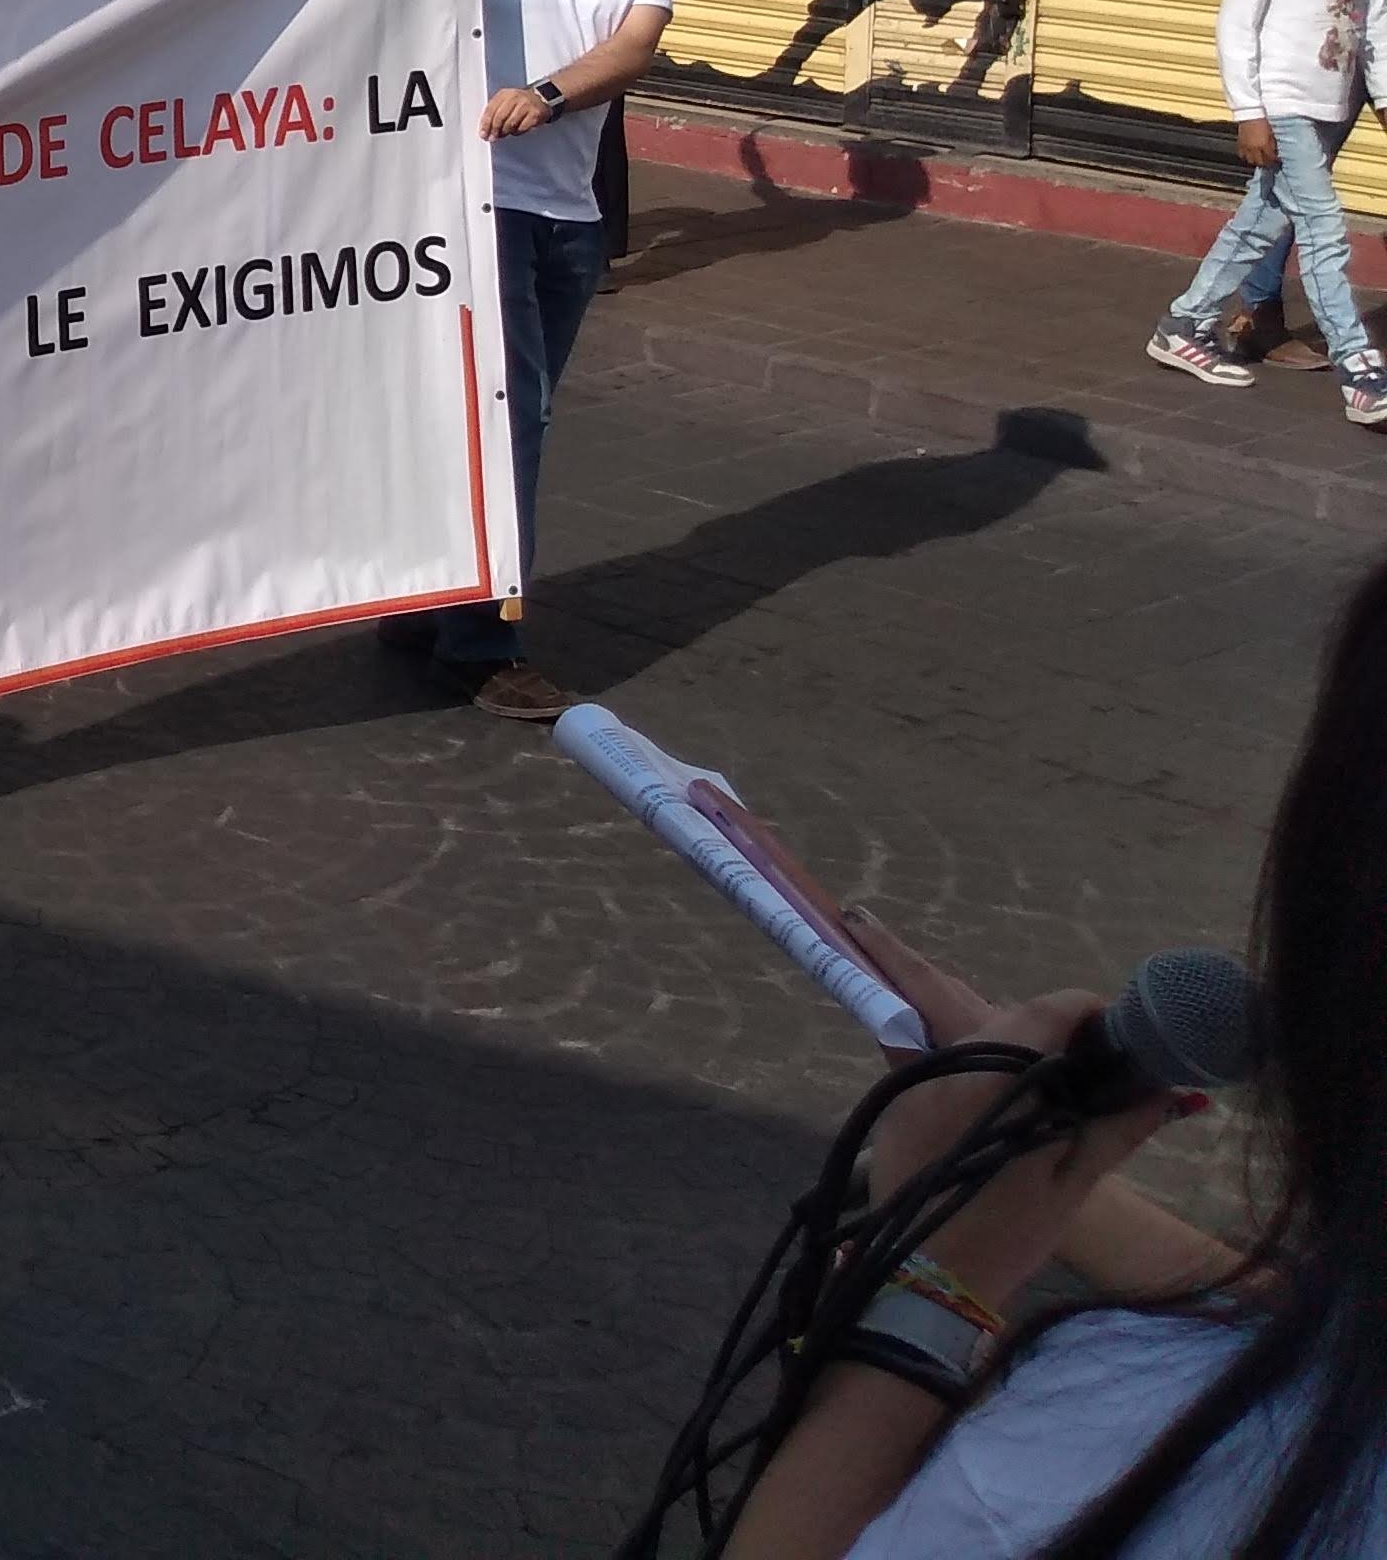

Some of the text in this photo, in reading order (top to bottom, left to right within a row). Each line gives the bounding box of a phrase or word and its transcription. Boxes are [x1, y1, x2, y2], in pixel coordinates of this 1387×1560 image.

[100, 82, 336, 167] CELAYA:
[367, 69, 444, 135] LA
[26, 284, 89, 358] LE
[137, 235, 453, 339] EXIGIMOS
